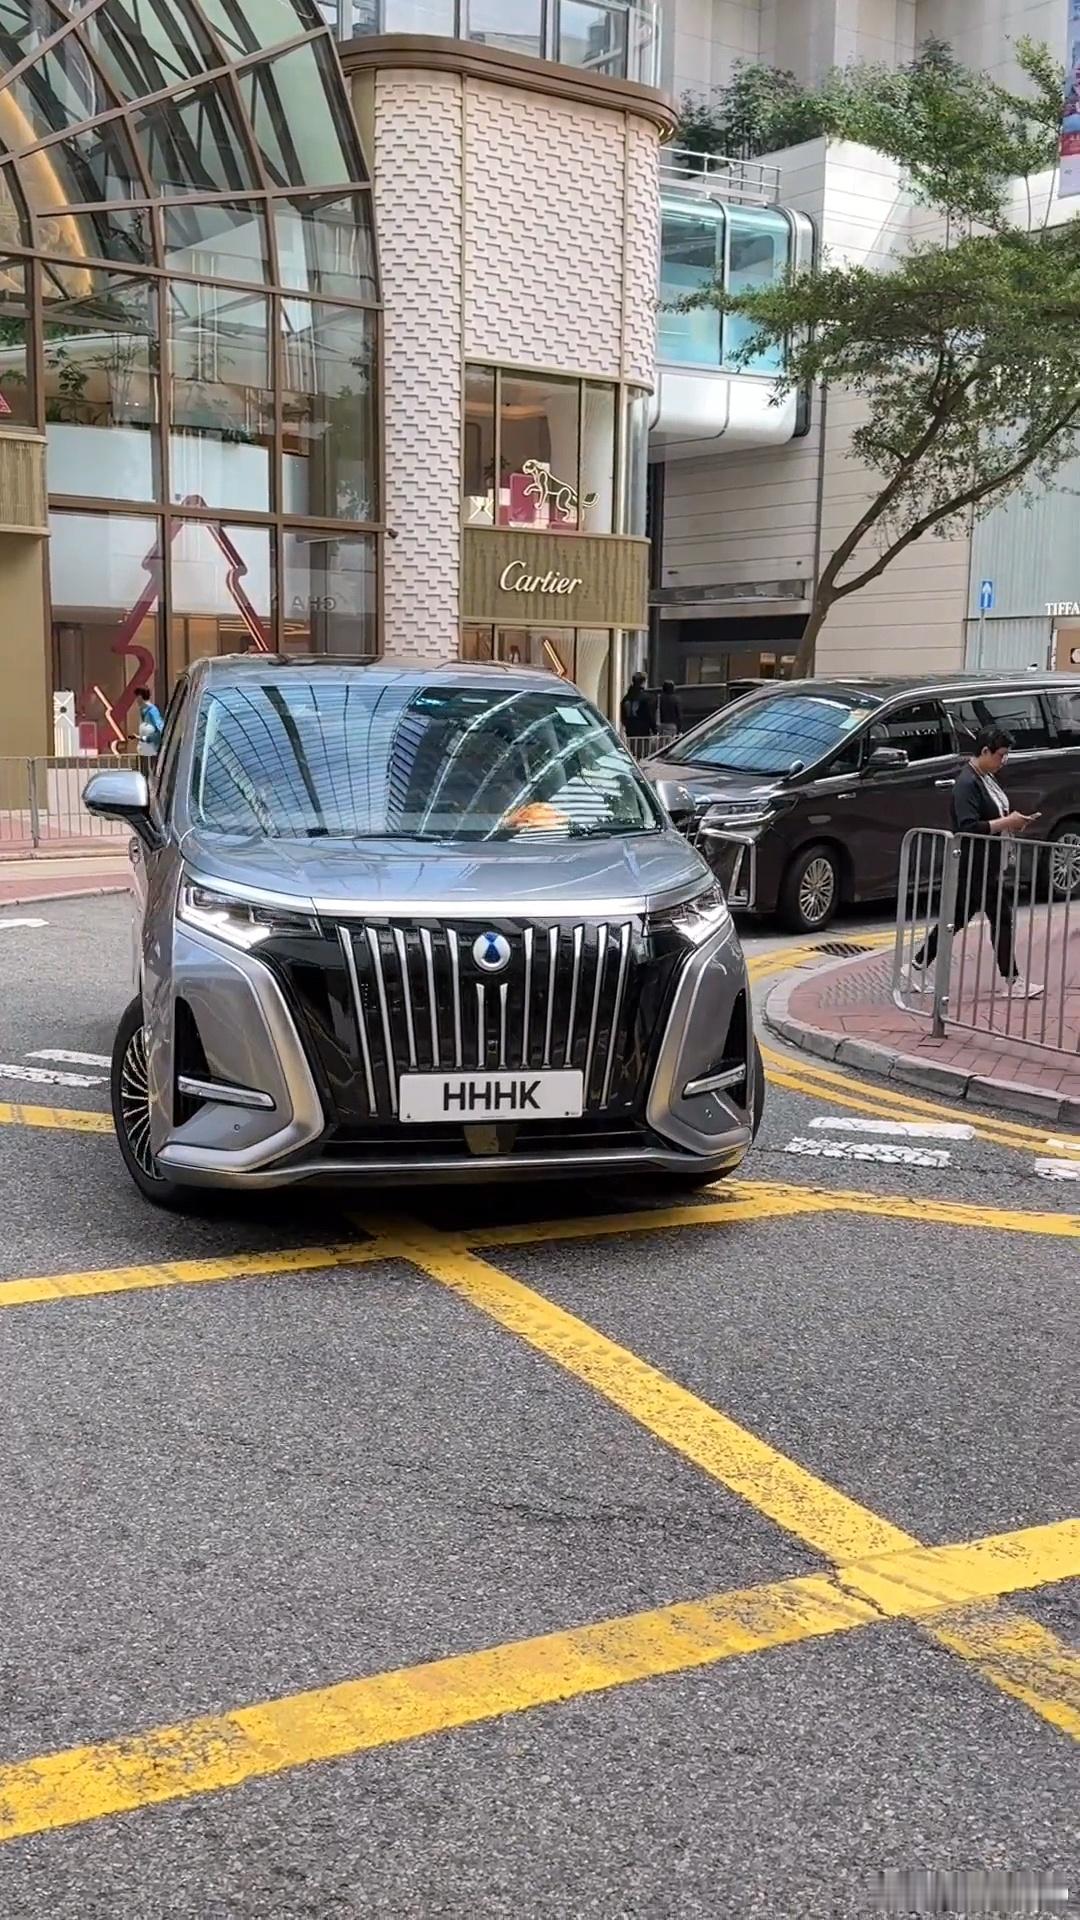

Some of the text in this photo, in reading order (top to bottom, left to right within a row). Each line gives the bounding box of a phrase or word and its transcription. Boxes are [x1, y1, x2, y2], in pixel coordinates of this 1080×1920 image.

[499, 560, 582, 593] Cartier
[1044, 602, 1080, 616] TIFFA
[443, 1080, 541, 1111] HHHK
